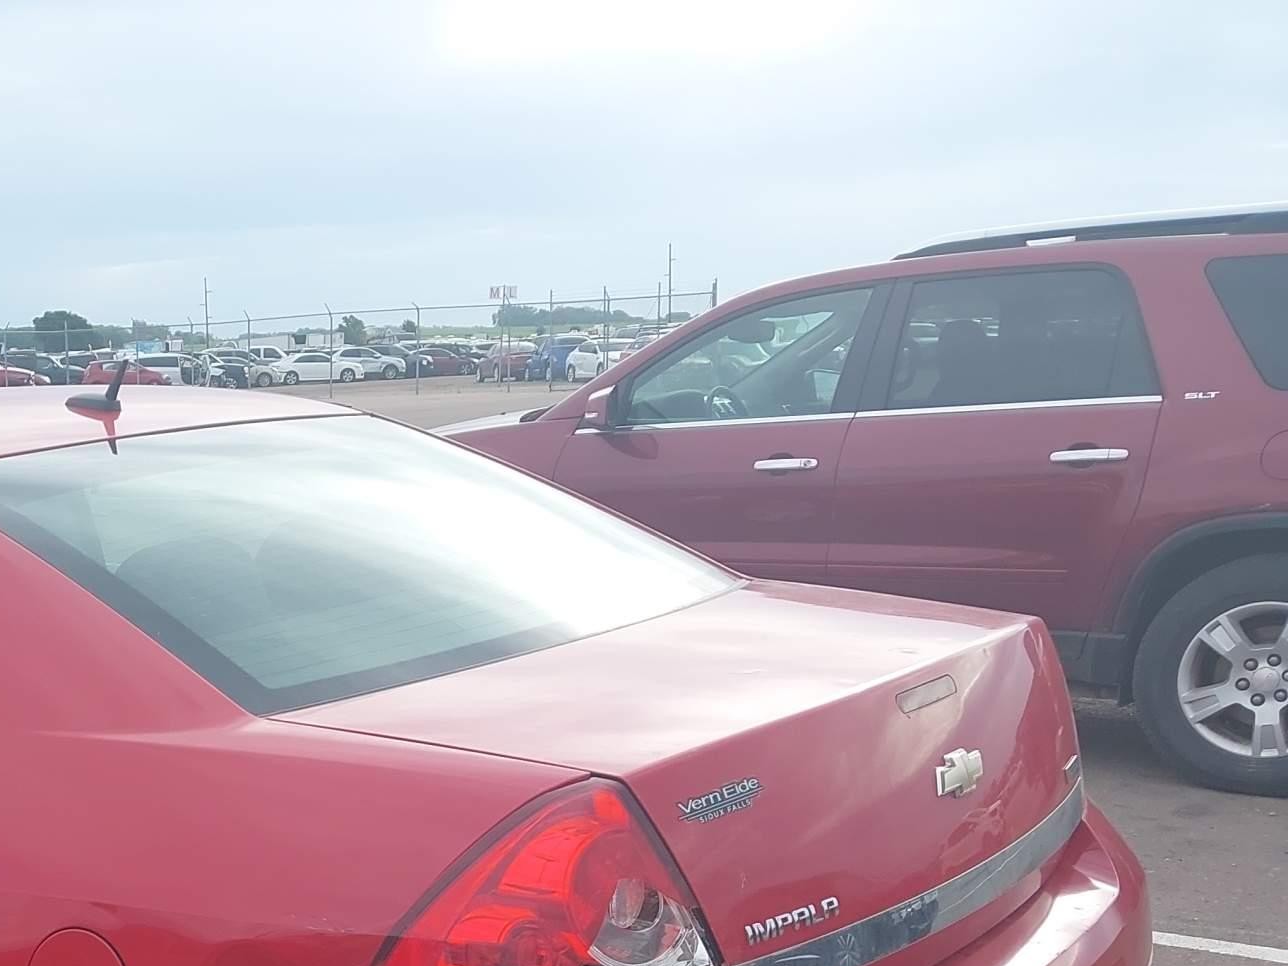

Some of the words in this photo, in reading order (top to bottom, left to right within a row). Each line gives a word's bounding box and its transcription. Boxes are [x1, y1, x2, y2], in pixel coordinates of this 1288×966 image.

[1183, 390, 1221, 400] SLT
[677, 790, 722, 814] Vern
[722, 778, 759, 799] Eide
[699, 808, 725, 823] SIOUX
[726, 799, 752, 814] FALLS
[744, 896, 840, 945] IMPALA
